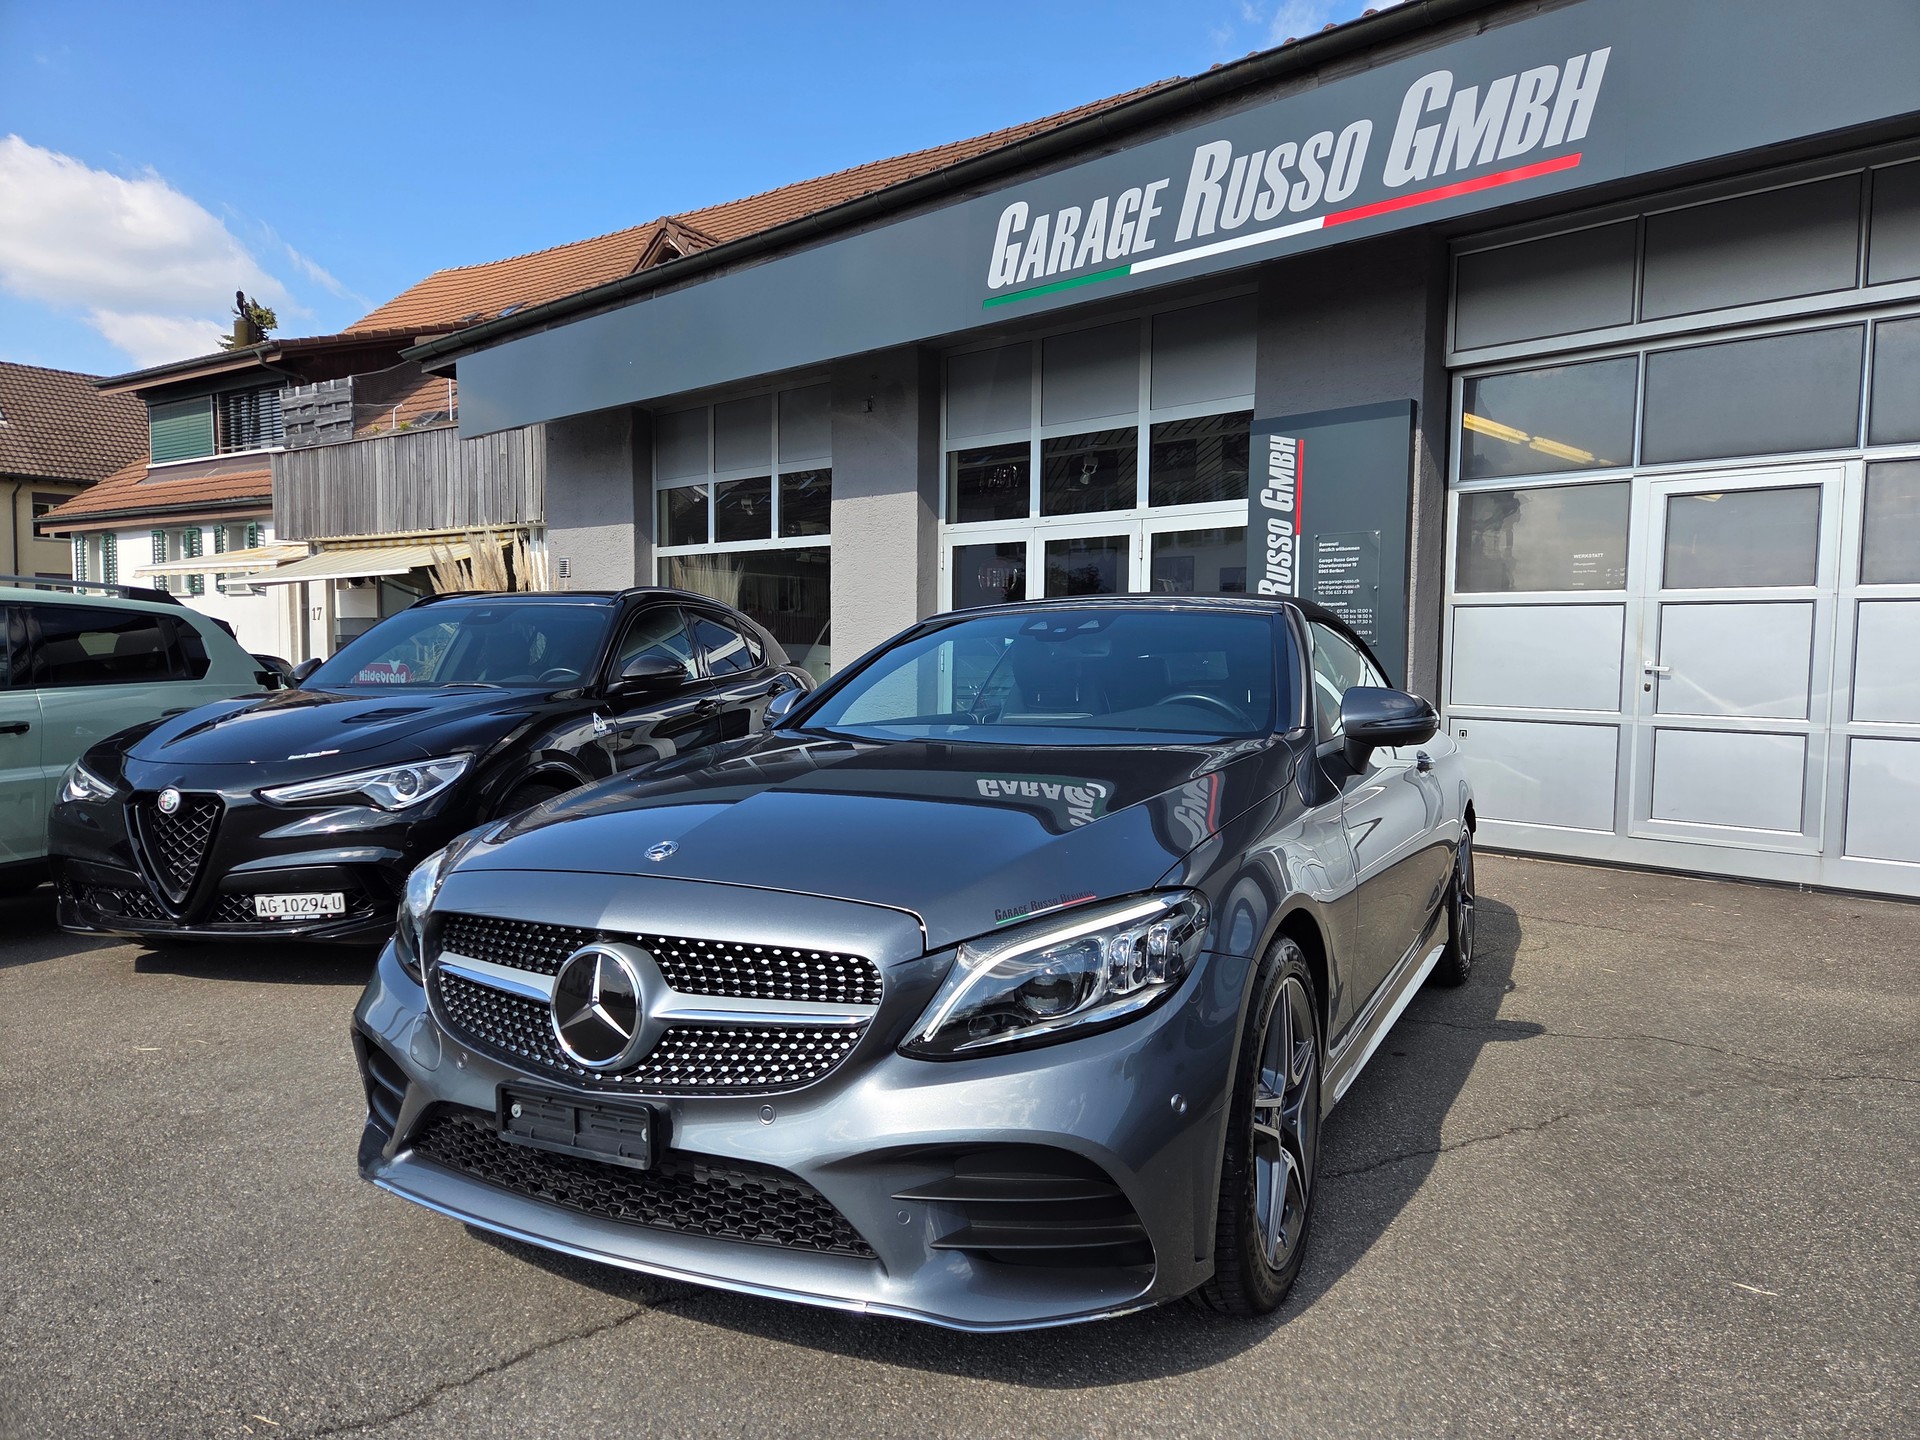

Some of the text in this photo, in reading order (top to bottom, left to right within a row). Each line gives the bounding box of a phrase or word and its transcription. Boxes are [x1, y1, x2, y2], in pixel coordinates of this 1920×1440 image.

[987, 46, 1612, 289] GARAGE RUSSO GMBH
[1258, 434, 1296, 596] RUSSO GMBH
[311, 606, 323, 621] 17
[359, 669, 407, 684] Hildebrand
[995, 904, 1028, 921] GARAGE
[1030, 897, 1059, 912] RUSSO
